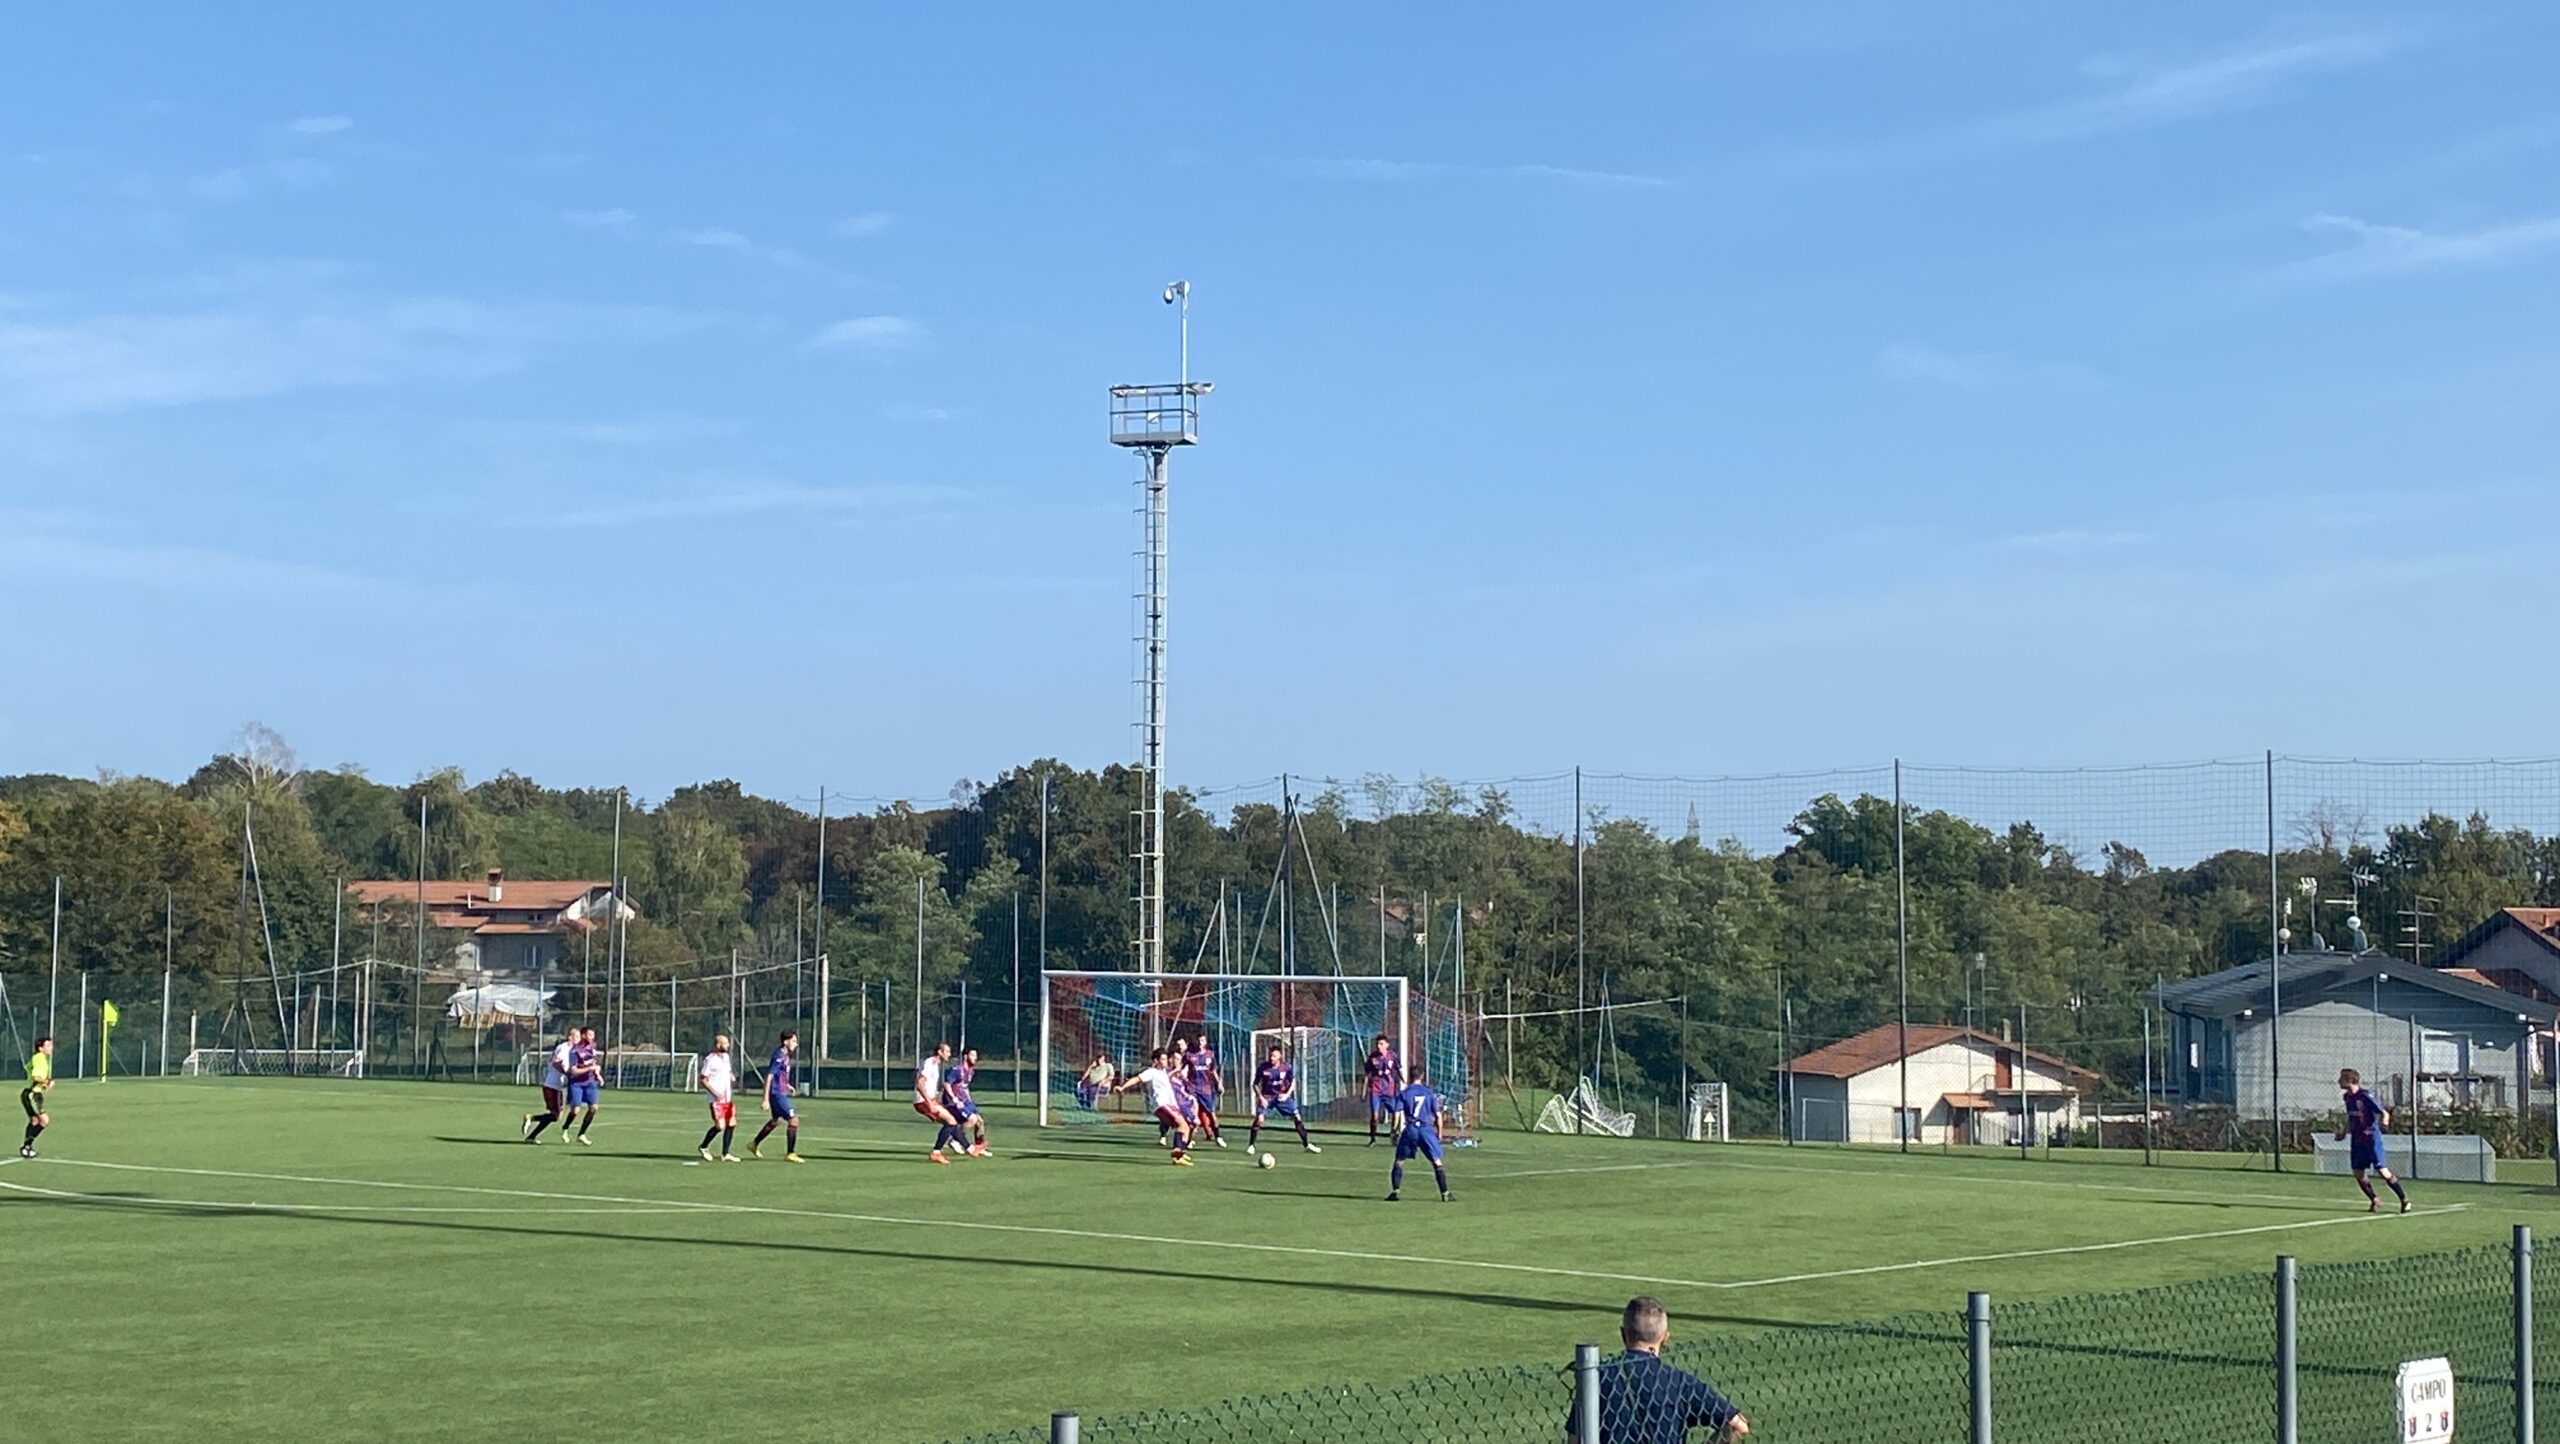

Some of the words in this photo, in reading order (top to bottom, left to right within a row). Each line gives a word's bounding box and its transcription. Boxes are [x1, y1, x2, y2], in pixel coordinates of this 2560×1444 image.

[1414, 1095, 1426, 1118] 7
[2411, 1378, 2446, 1403] CAMPO
[2425, 1412, 2432, 1432] 2
